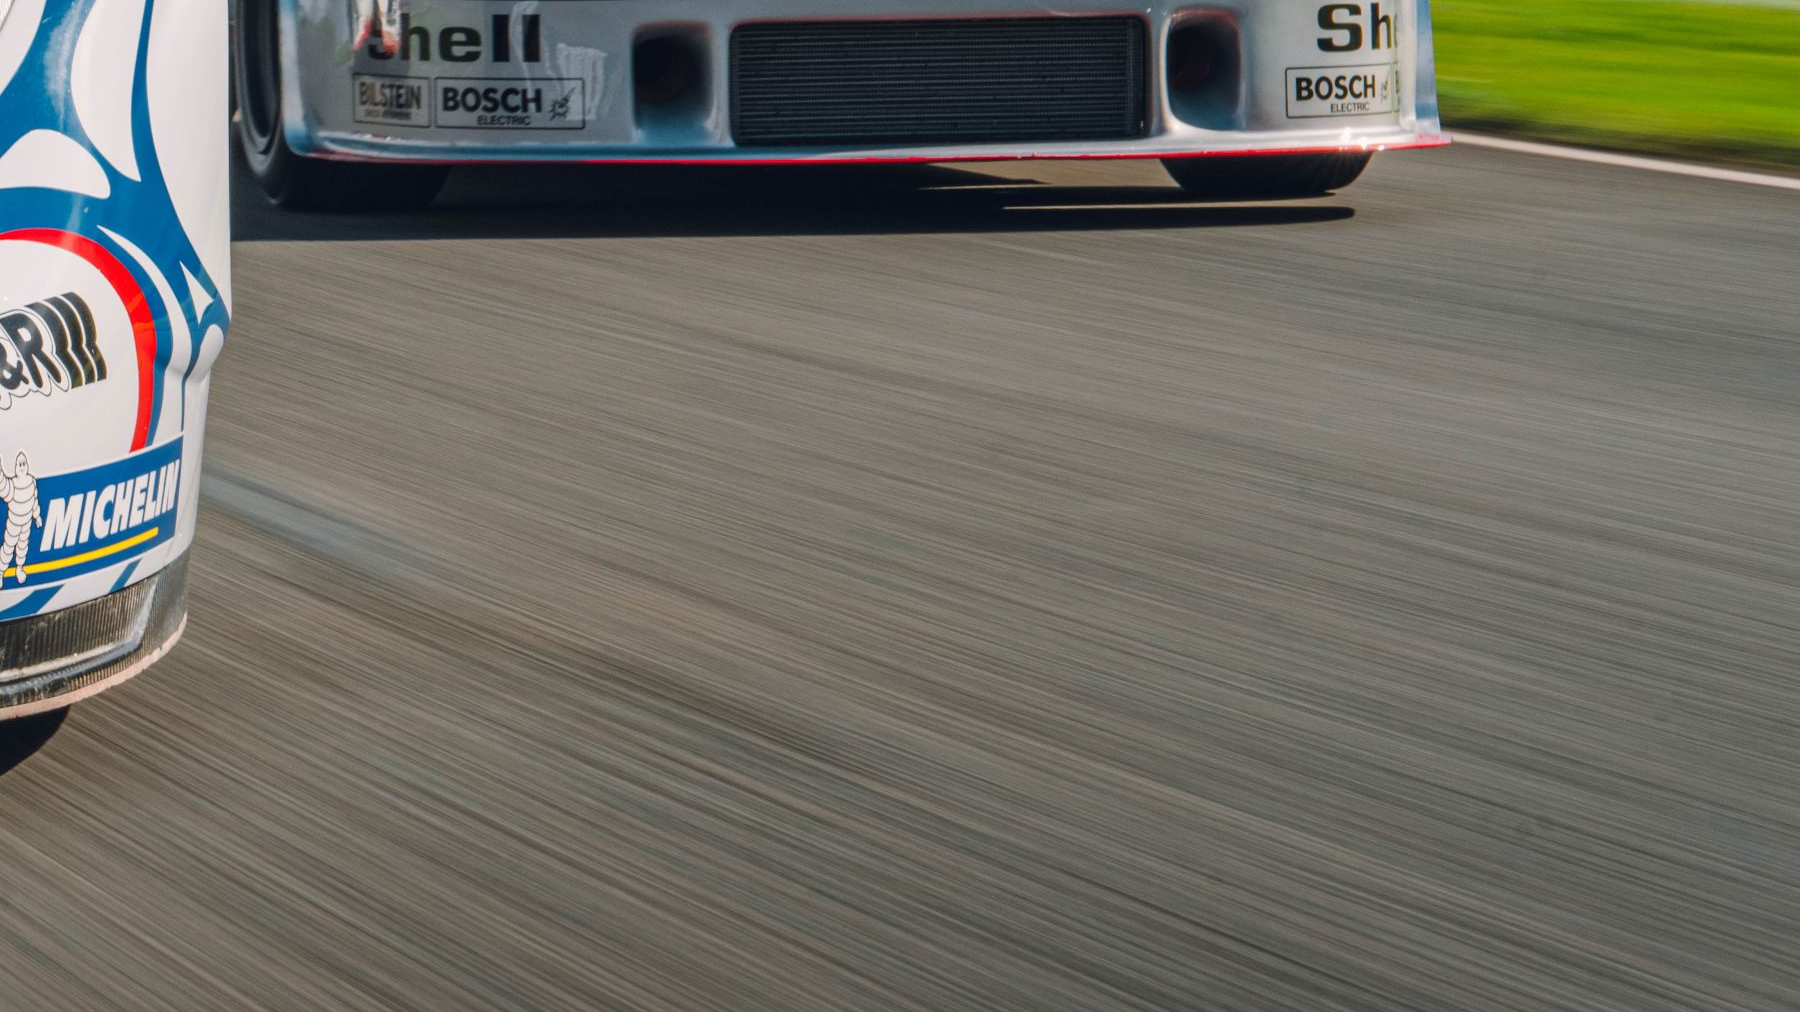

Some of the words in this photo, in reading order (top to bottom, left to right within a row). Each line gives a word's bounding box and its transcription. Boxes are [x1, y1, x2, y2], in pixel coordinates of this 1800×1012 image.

[1316, 2, 1398, 53] Sh
[442, 87, 542, 113] BOSCH
[1296, 74, 1376, 102] BOSCH
[477, 114, 532, 126] ELECTRIC
[1330, 101, 1370, 114] ELECTRIC
[39, 459, 180, 553] MICHELIN
